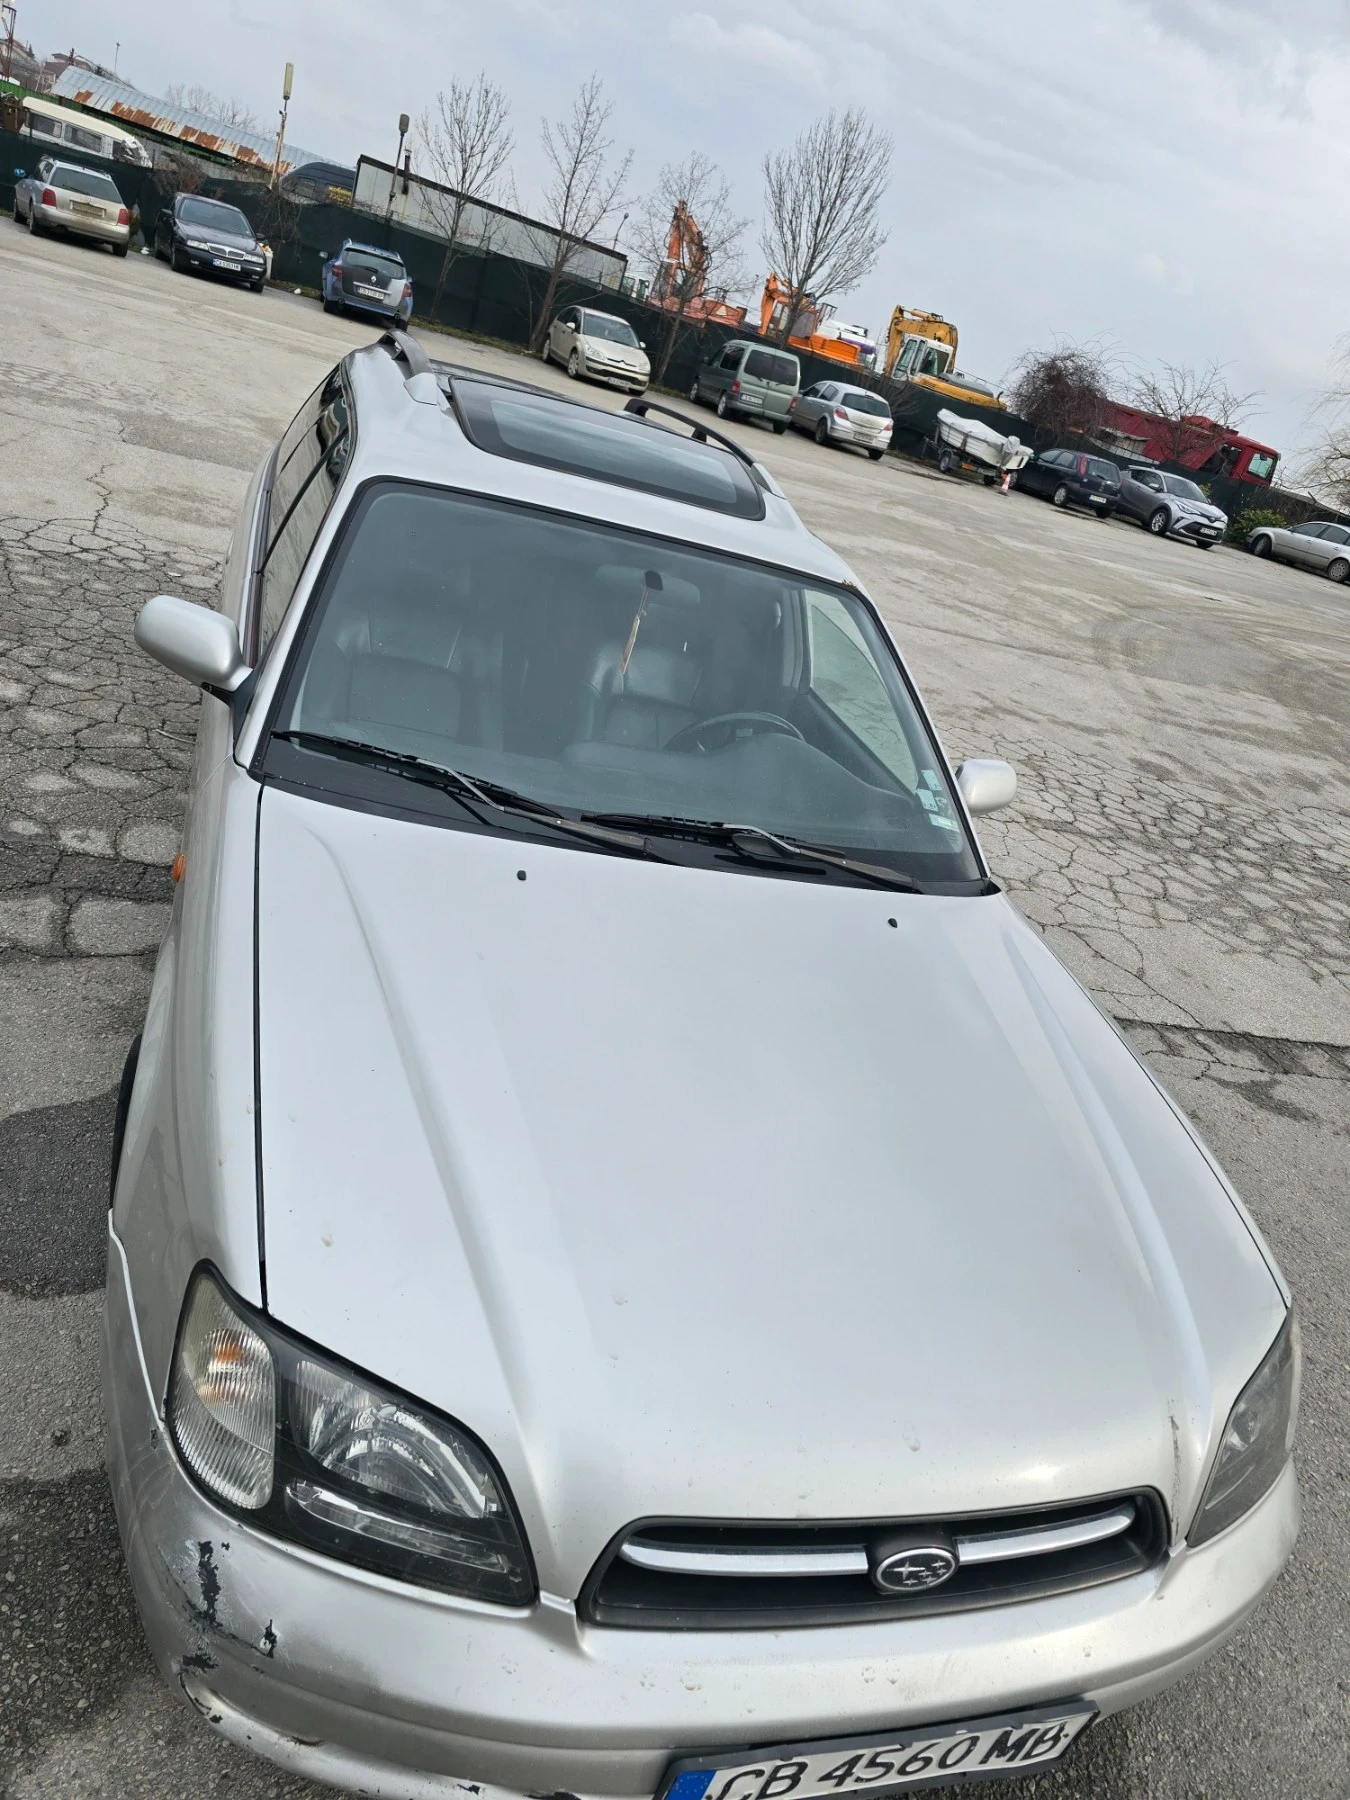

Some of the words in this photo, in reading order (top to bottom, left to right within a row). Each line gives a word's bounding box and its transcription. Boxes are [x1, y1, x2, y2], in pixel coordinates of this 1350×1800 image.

[714, 1761, 809, 1800] CB
[817, 1735, 980, 1787] 4560
[979, 1722, 1067, 1765] MB
